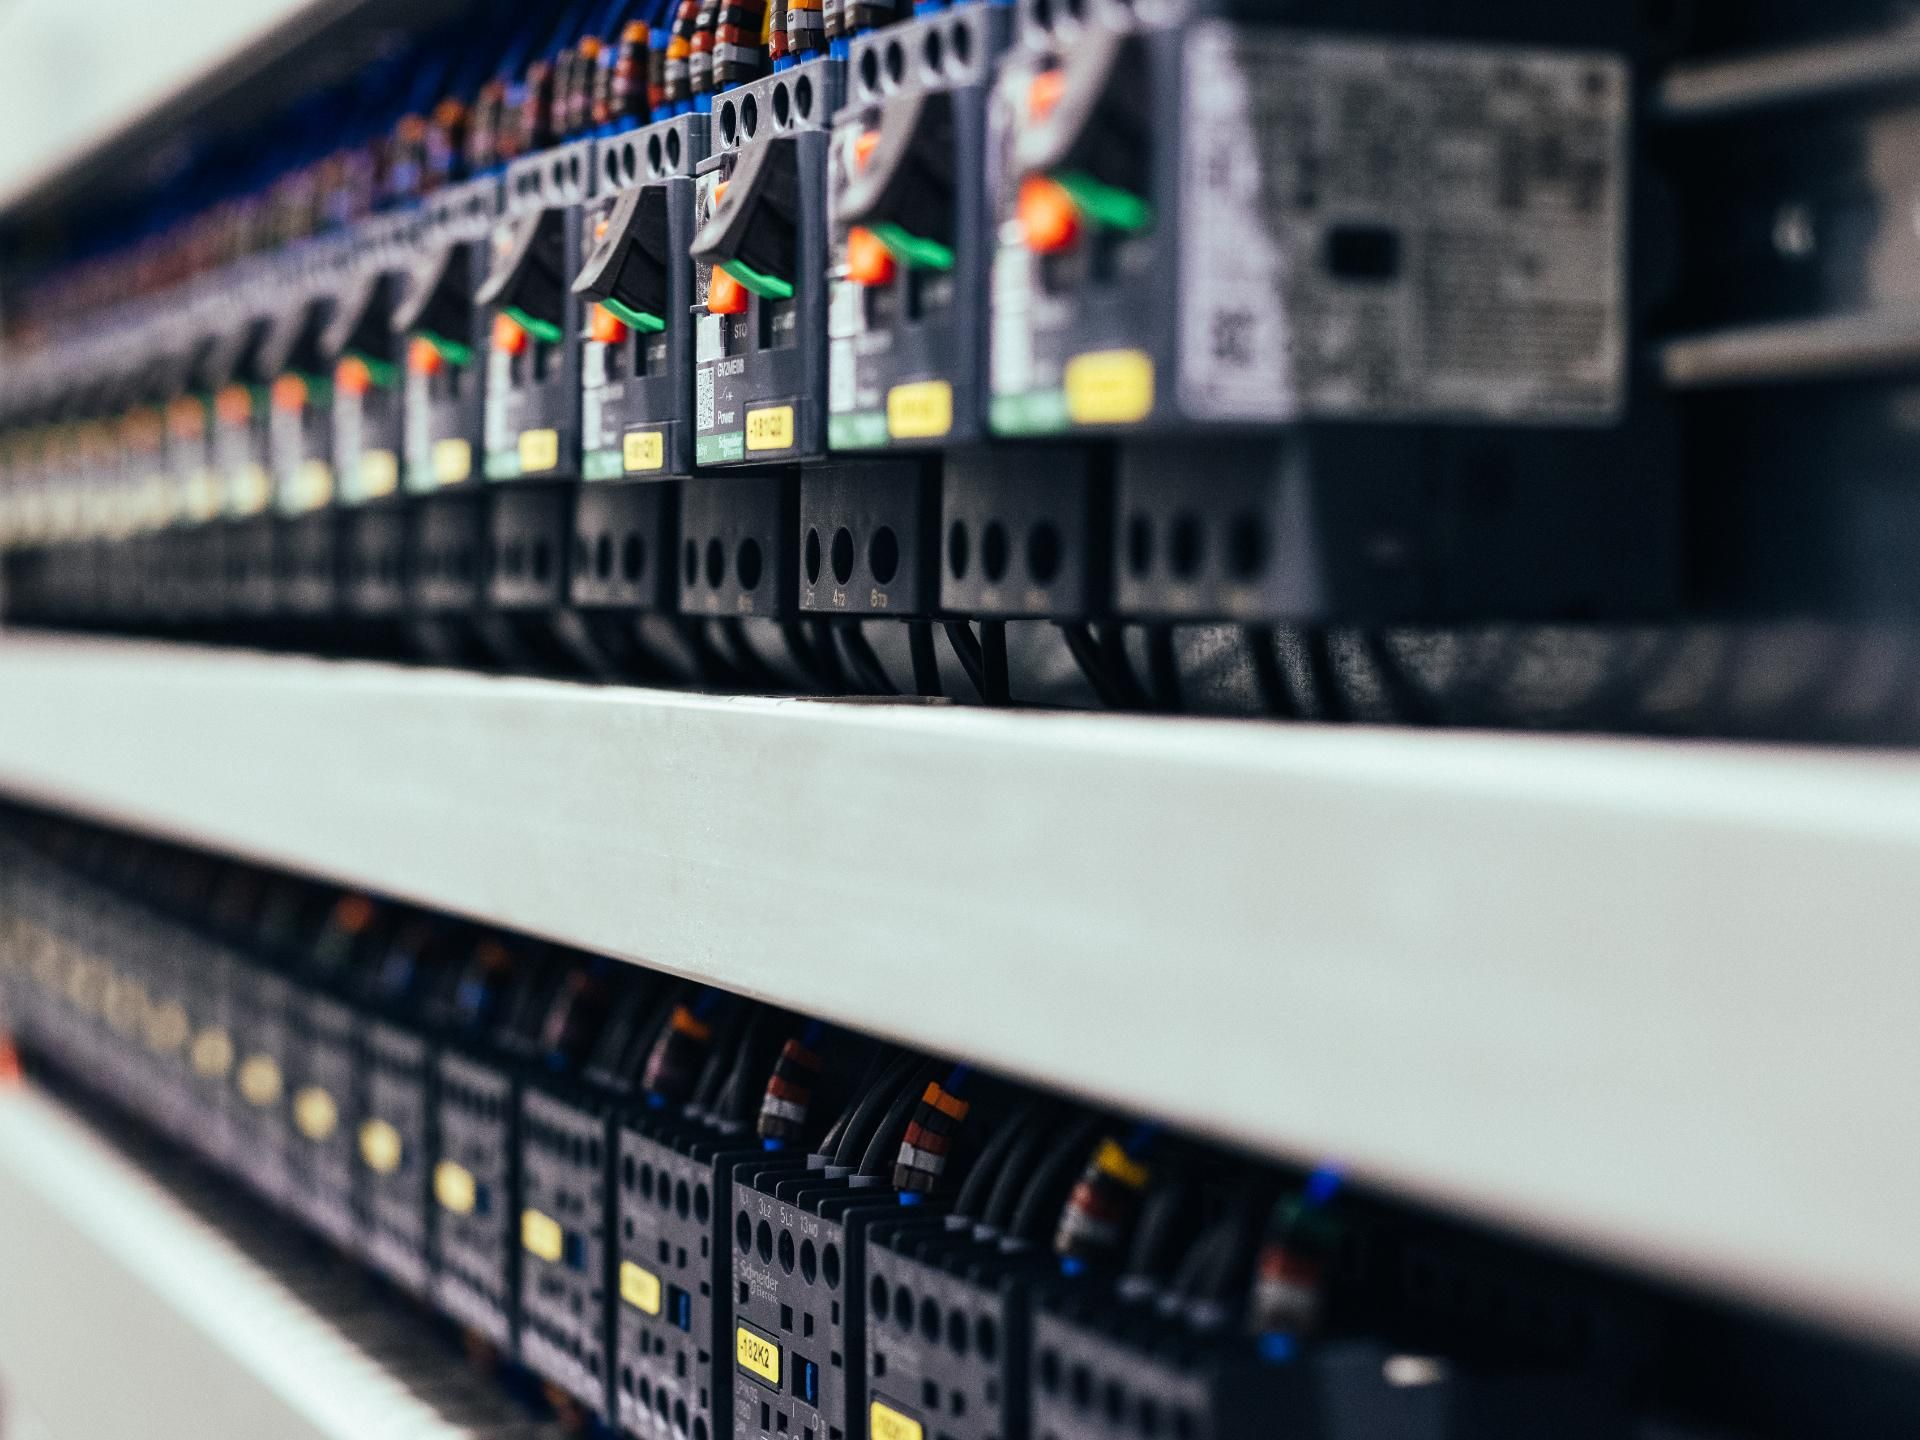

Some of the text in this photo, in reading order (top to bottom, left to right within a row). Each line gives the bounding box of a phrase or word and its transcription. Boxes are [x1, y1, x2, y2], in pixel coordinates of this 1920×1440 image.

[758, 1198, 771, 1218] 3L2
[739, 1260, 779, 1292] Schneider
[756, 1284, 779, 1305] Electric
[740, 1338, 770, 1369] -182K2
